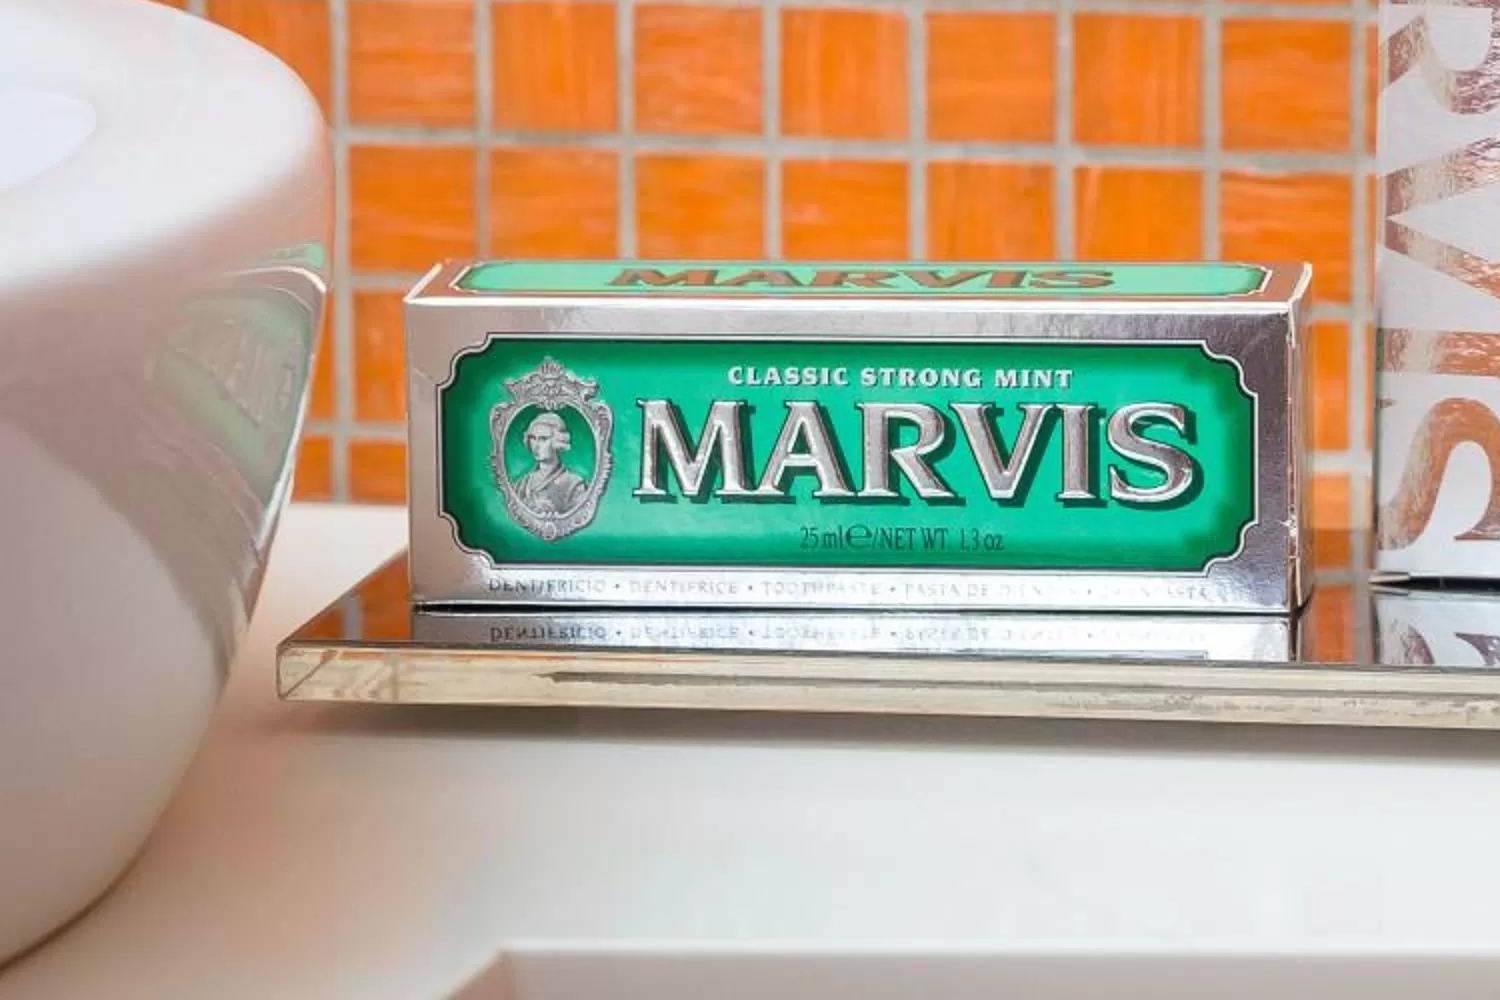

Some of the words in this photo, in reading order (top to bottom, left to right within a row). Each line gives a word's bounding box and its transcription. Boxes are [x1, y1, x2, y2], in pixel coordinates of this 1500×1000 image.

[606, 268, 1115, 288] MARVIS
[728, 366, 849, 386] CLASSIC
[860, 367, 983, 388] STRONG
[994, 369, 1073, 388] MINT
[632, 399, 1200, 505] MARVIS
[921, 527, 949, 550] WT
[960, 527, 980, 550] 1.3
[983, 533, 1004, 550] oz
[489, 578, 605, 594] DENTIFRICIO
[629, 579, 738, 595] DENTIFRICE
